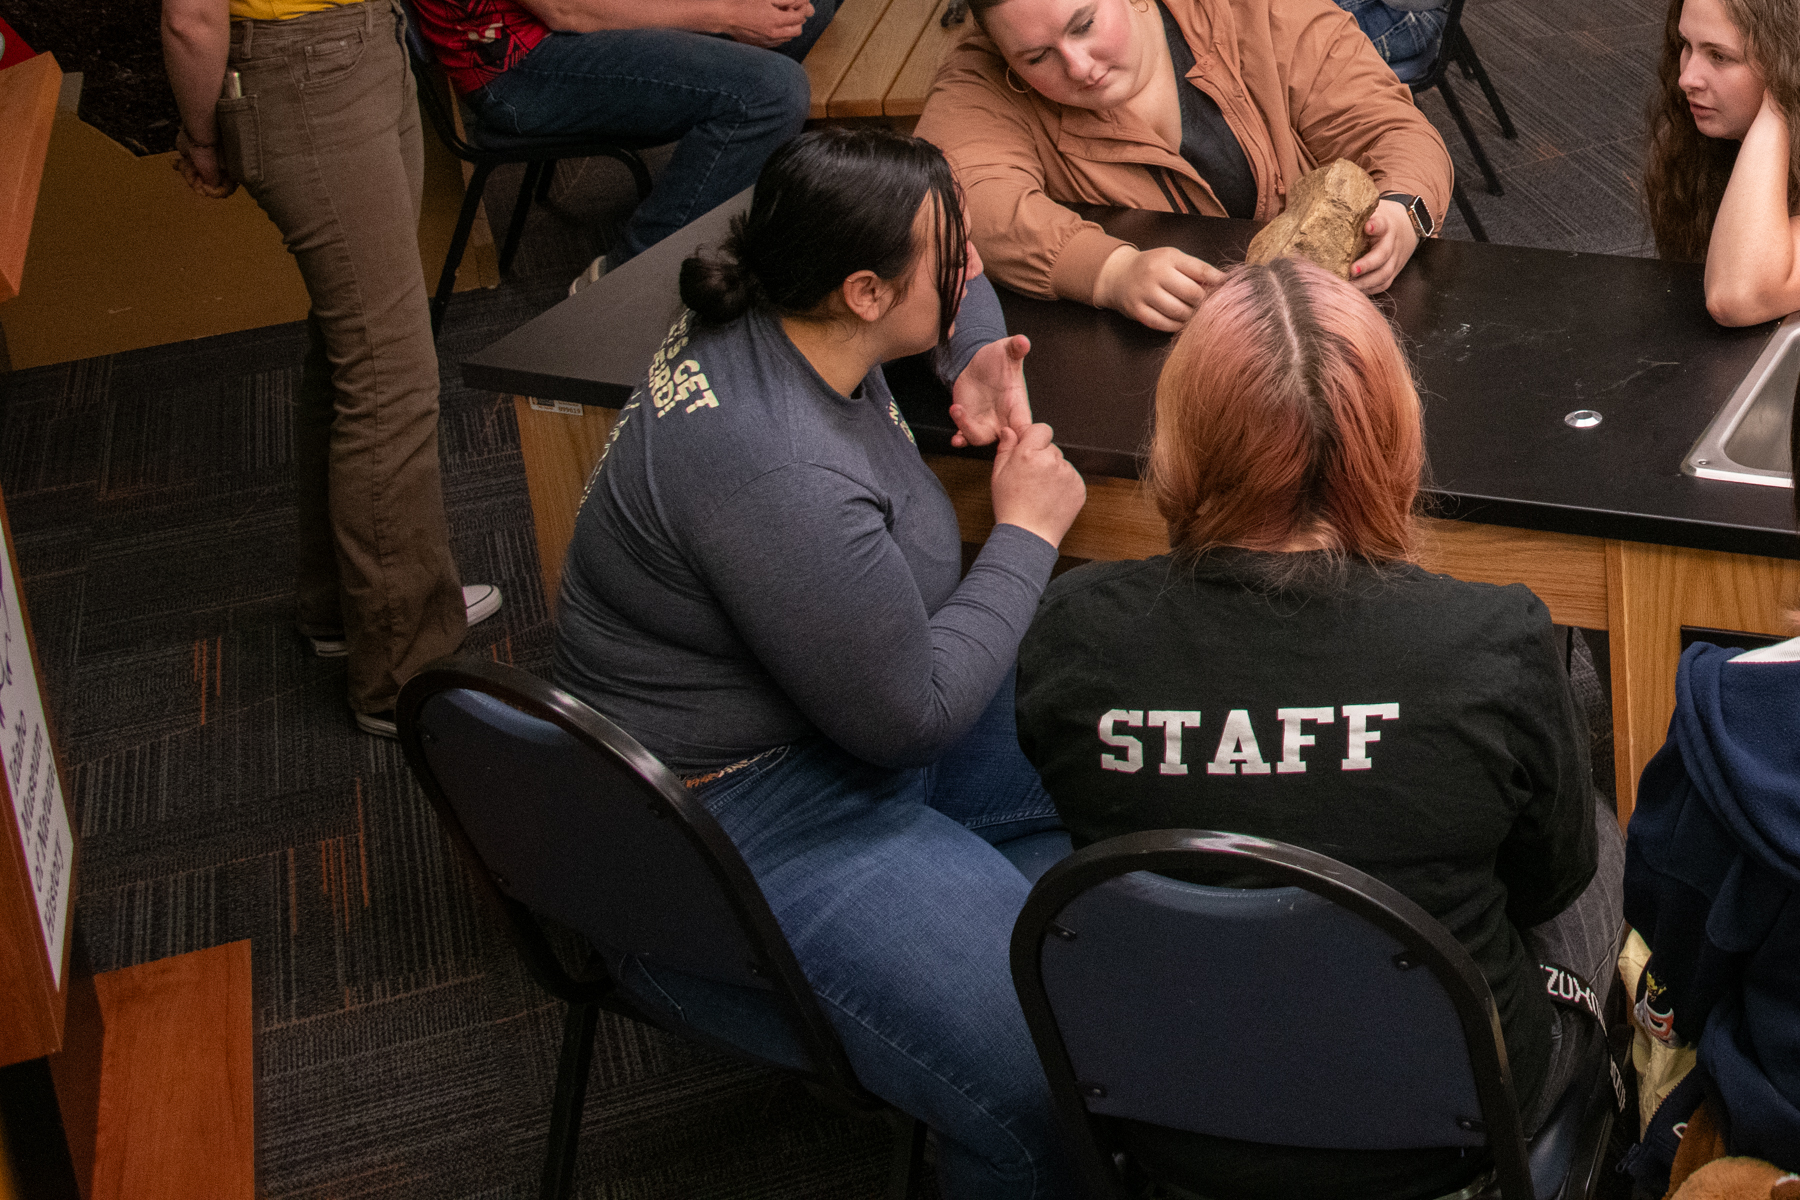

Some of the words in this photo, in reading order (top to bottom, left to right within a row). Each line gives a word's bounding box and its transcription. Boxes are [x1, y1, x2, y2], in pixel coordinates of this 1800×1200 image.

[9, 707, 27, 795] Idaho
[21, 721, 43, 845] Museum
[1099, 702, 1400, 775] STAFF
[37, 742, 56, 862] Natural
[44, 826, 64, 945] History
